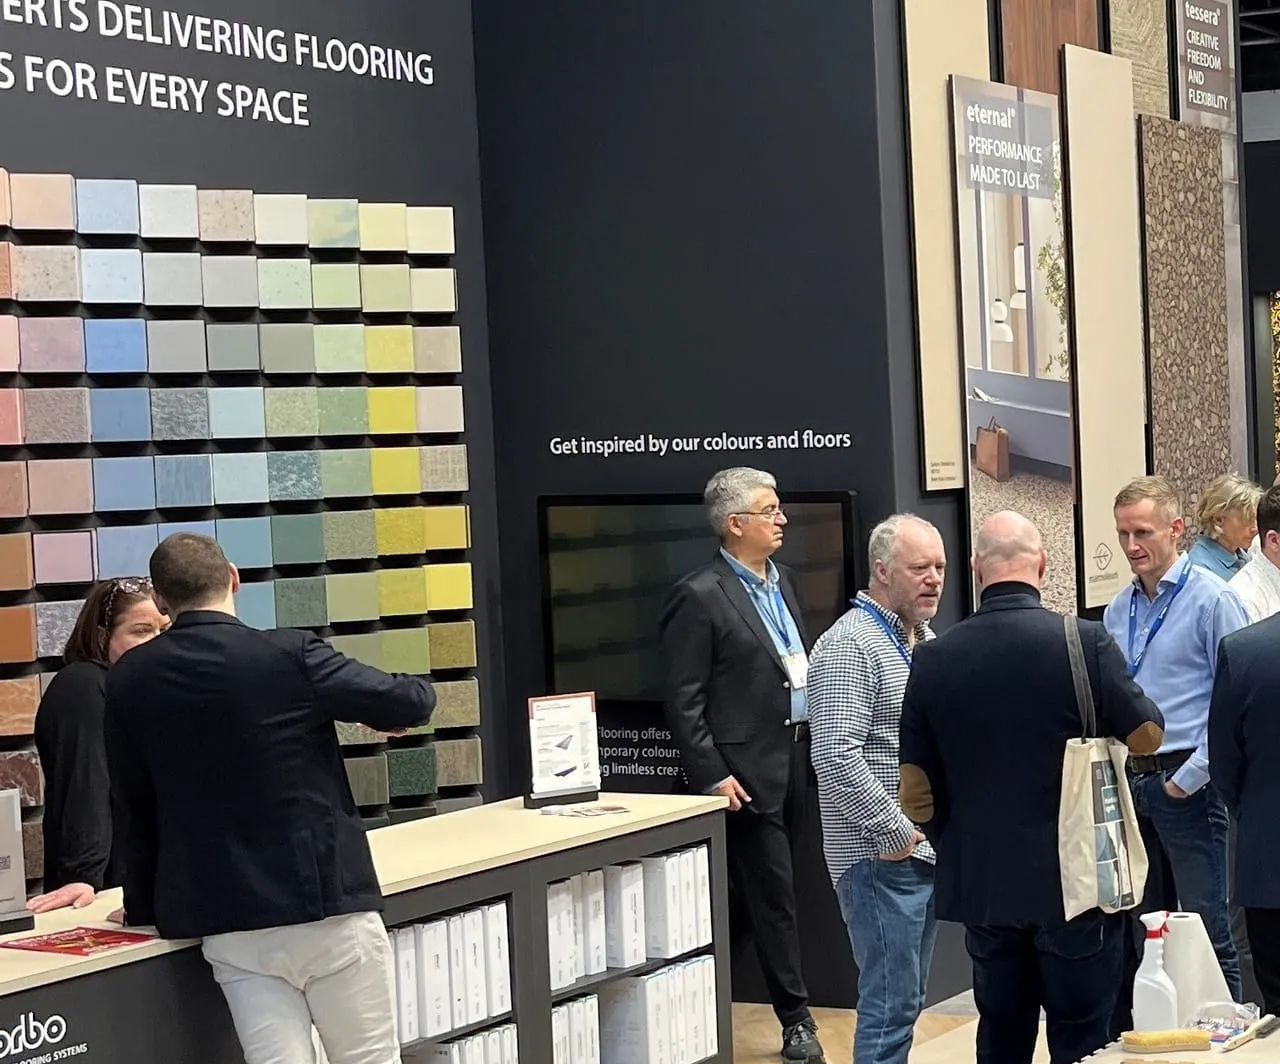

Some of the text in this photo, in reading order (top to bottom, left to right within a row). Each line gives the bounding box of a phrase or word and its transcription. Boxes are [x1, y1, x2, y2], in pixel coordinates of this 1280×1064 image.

[1185, 1, 1218, 26] tessera
[98, 0, 287, 63] DELIVERING
[295, 33, 434, 85] FLOORING
[1186, 29, 1219, 51] CREATIVE
[1187, 49, 1222, 71] FREEDOM
[1188, 68, 1204, 85] AND
[25, 55, 98, 100] FOR
[105, 66, 208, 113] EVERY
[217, 82, 310, 126] SPACE
[1188, 88, 1228, 110] FLEXIBILITY
[969, 135, 1042, 164] PERFORMANCE
[970, 163, 1040, 190] MADE TO LAST
[550, 429, 851, 457] Get inspired by our colours and floors
[599, 726, 671, 742] looring offers
[611, 762, 655, 775] limitless
[53, 1042, 88, 1061] SYSTEMS
